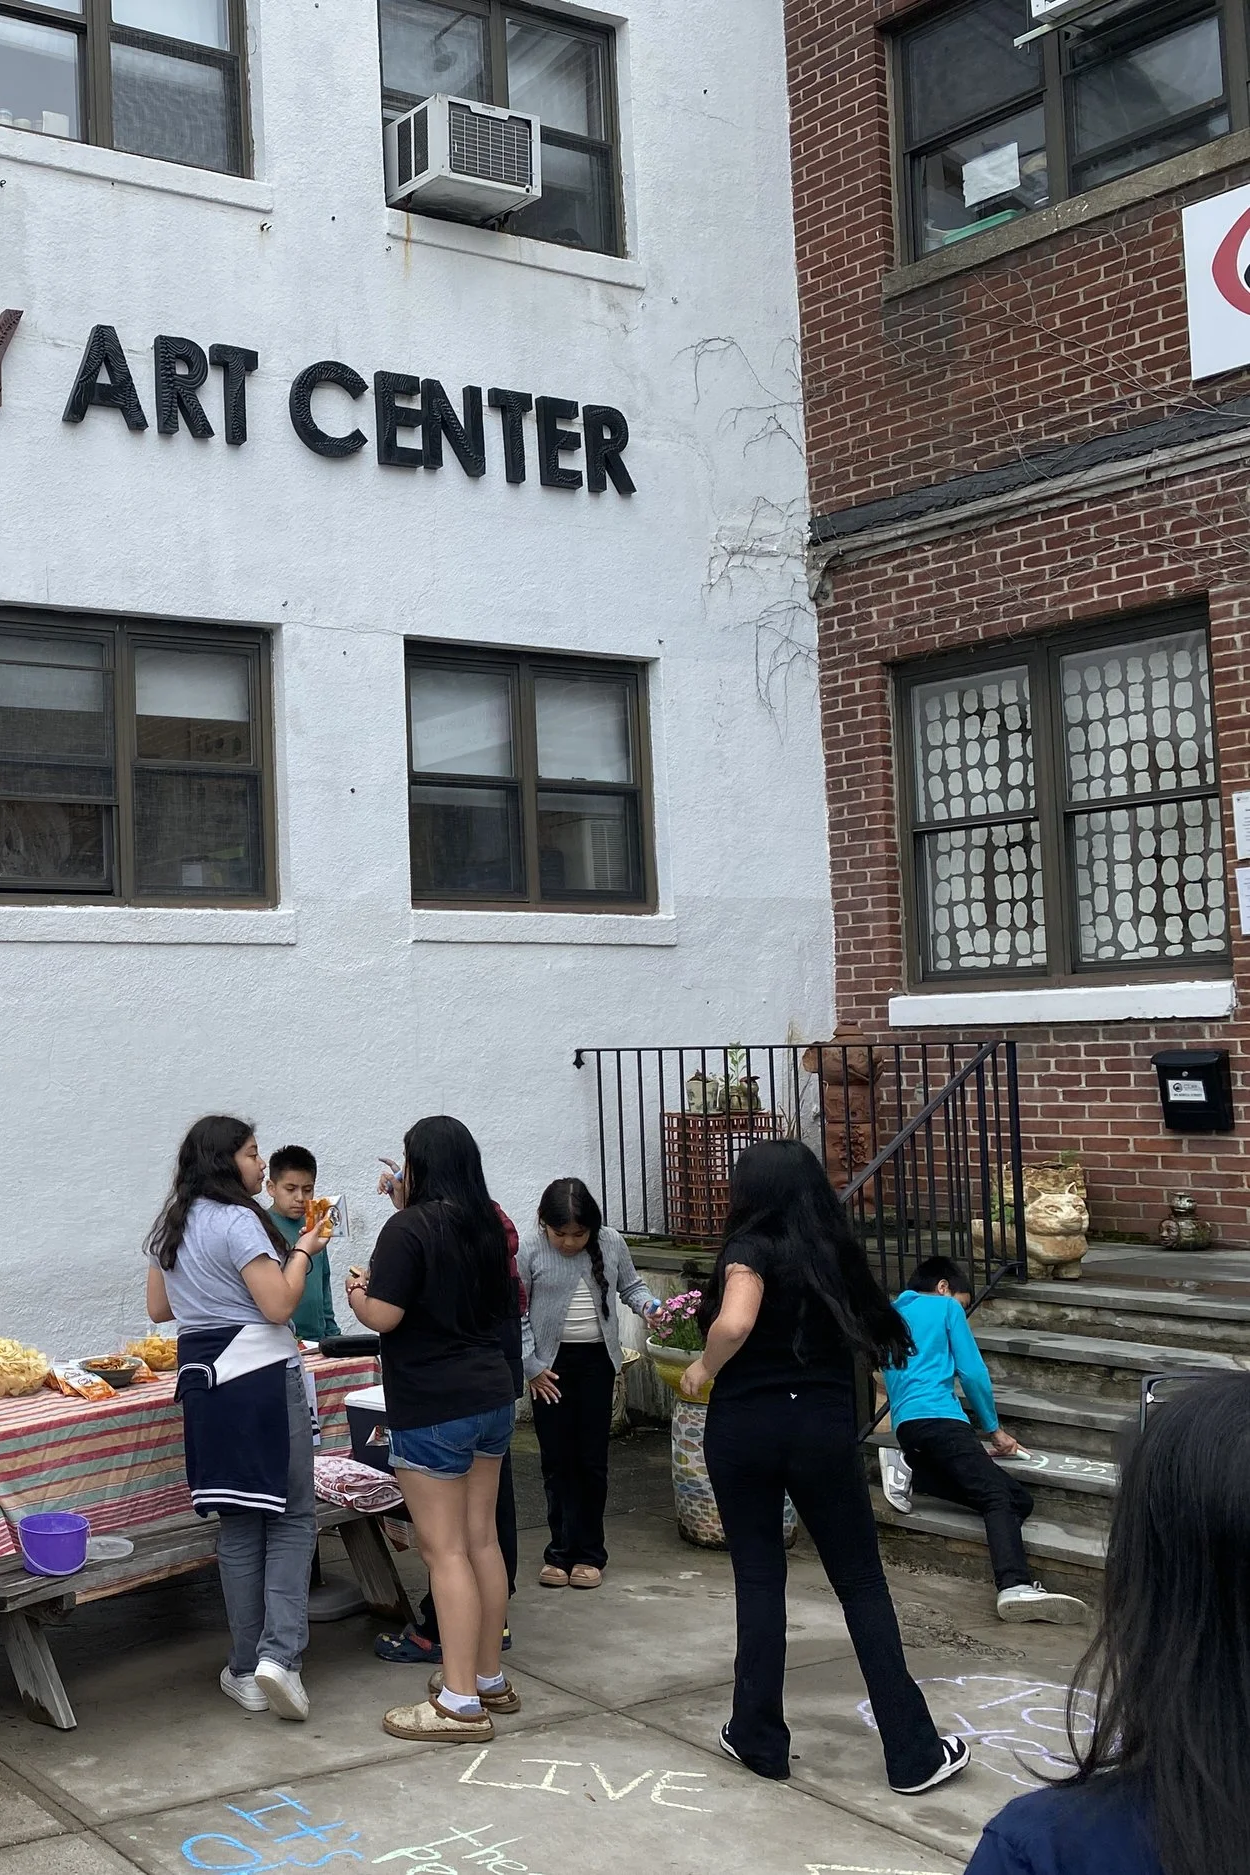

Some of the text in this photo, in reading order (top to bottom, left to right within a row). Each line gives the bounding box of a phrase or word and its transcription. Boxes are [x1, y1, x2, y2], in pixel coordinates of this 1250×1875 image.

[62, 324, 258, 445] ART
[290, 360, 637, 495] CENTER
[459, 1749, 713, 1812] LIVE
